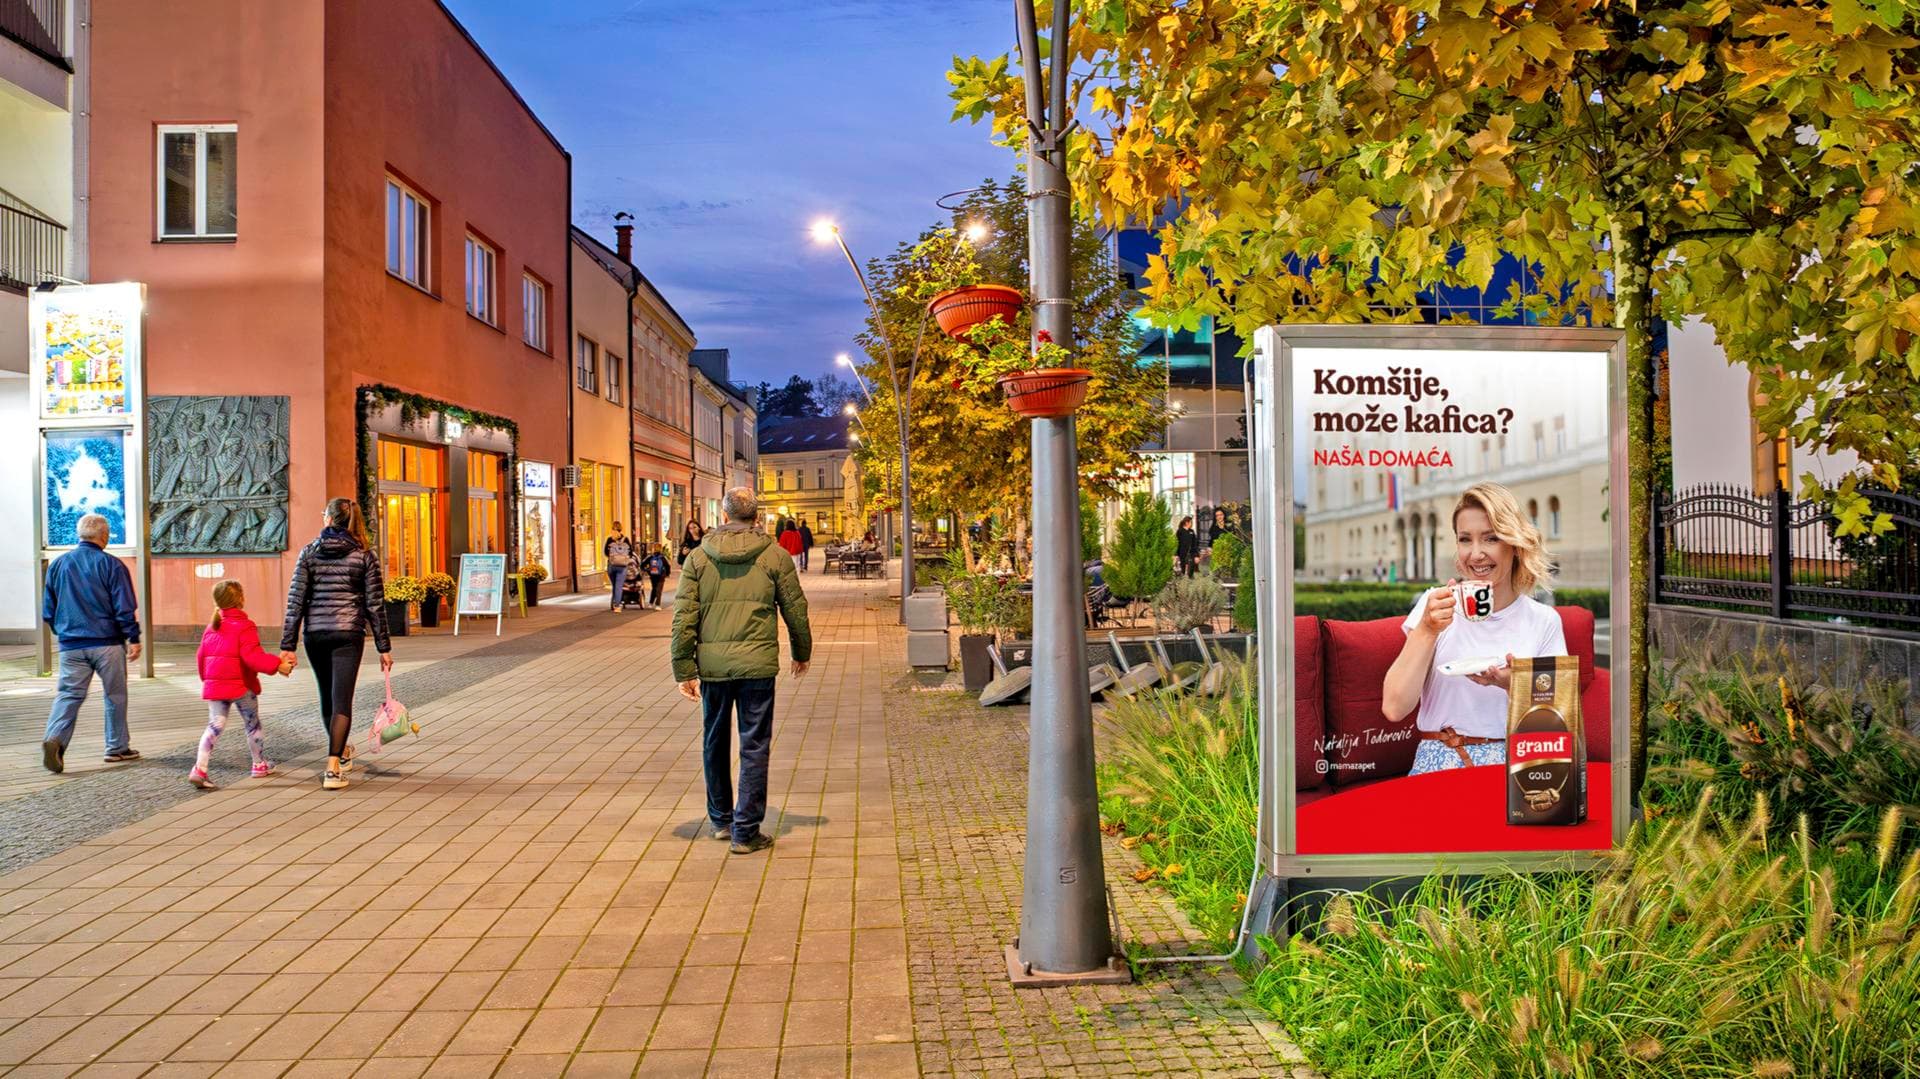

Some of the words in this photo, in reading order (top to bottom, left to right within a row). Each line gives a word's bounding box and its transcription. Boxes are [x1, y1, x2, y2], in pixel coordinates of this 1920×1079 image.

[1313, 366, 1449, 401] Komšije,
[1313, 404, 1398, 433] može
[1404, 405, 1514, 434] kafica?
[1314, 446, 1365, 467] NAŠA
[1368, 446, 1453, 467] DOMAĆA
[1313, 733, 1359, 758] Natalija
[1362, 724, 1414, 745] Todorović
[1516, 736, 1567, 757] grand
[1330, 762, 1376, 772] mamazapet
[1528, 772, 1552, 780] GOLD
